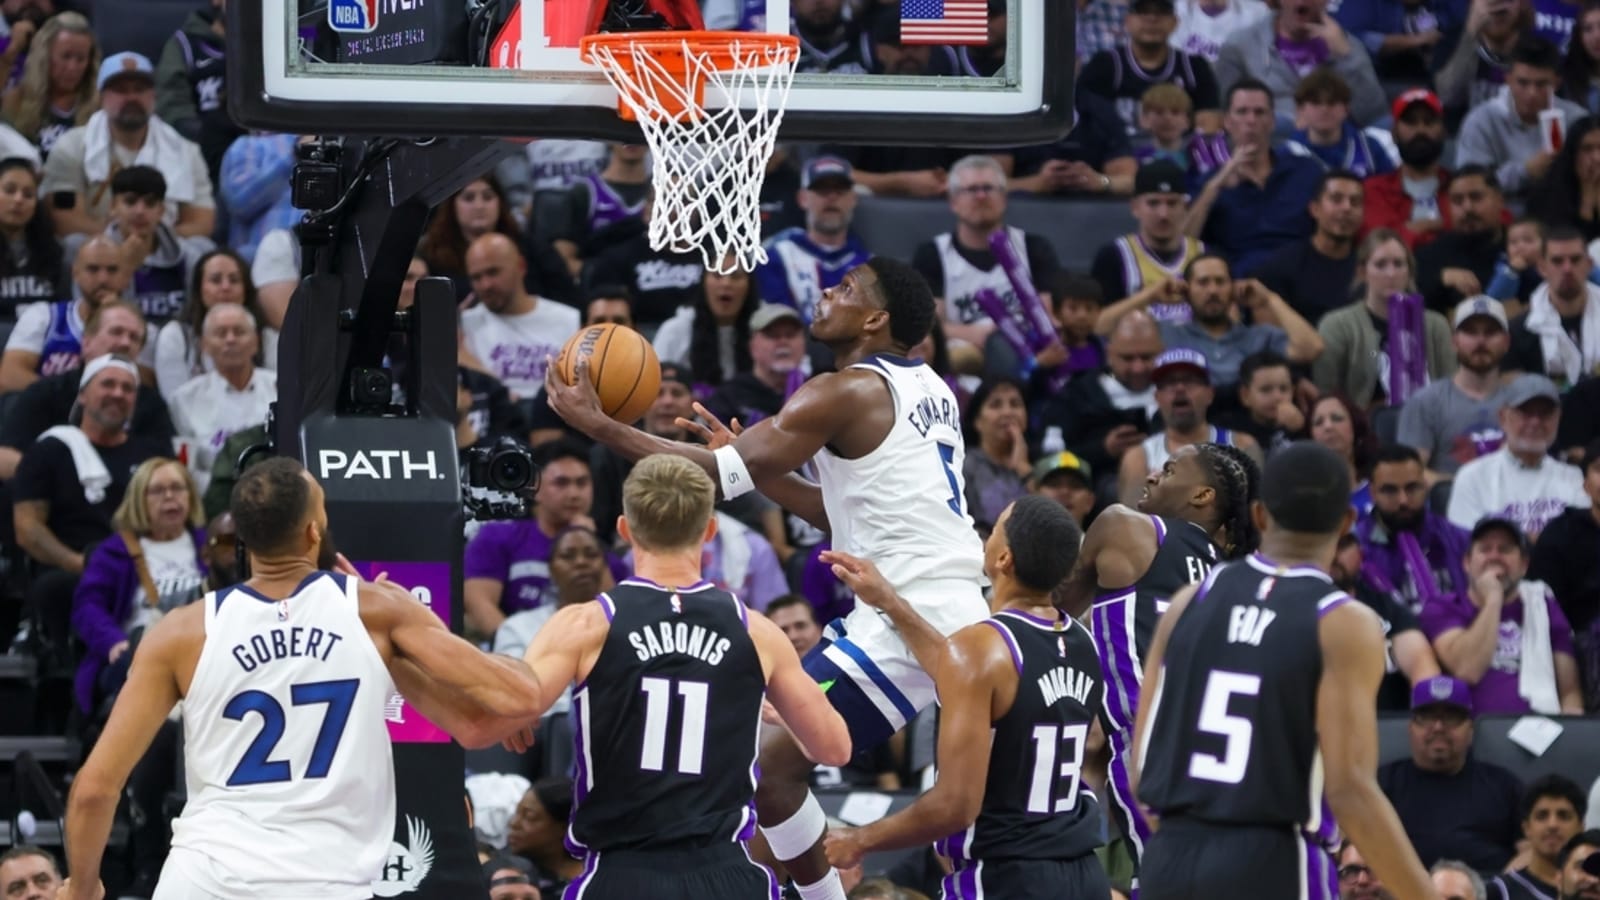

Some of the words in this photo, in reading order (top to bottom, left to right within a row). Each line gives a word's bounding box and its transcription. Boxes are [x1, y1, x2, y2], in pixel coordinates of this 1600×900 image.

[335, 5, 360, 25] NBA
[728, 471, 740, 485] 5
[936, 440, 964, 519] 5
[628, 621, 731, 666] SABONIS
[1227, 605, 1277, 647] FOX
[232, 627, 343, 673] GOBERT
[1037, 666, 1095, 708] MURRAY
[222, 677, 361, 787] 27
[640, 676, 709, 775] 11
[1188, 668, 1262, 784] 5
[1026, 723, 1088, 813] 13
